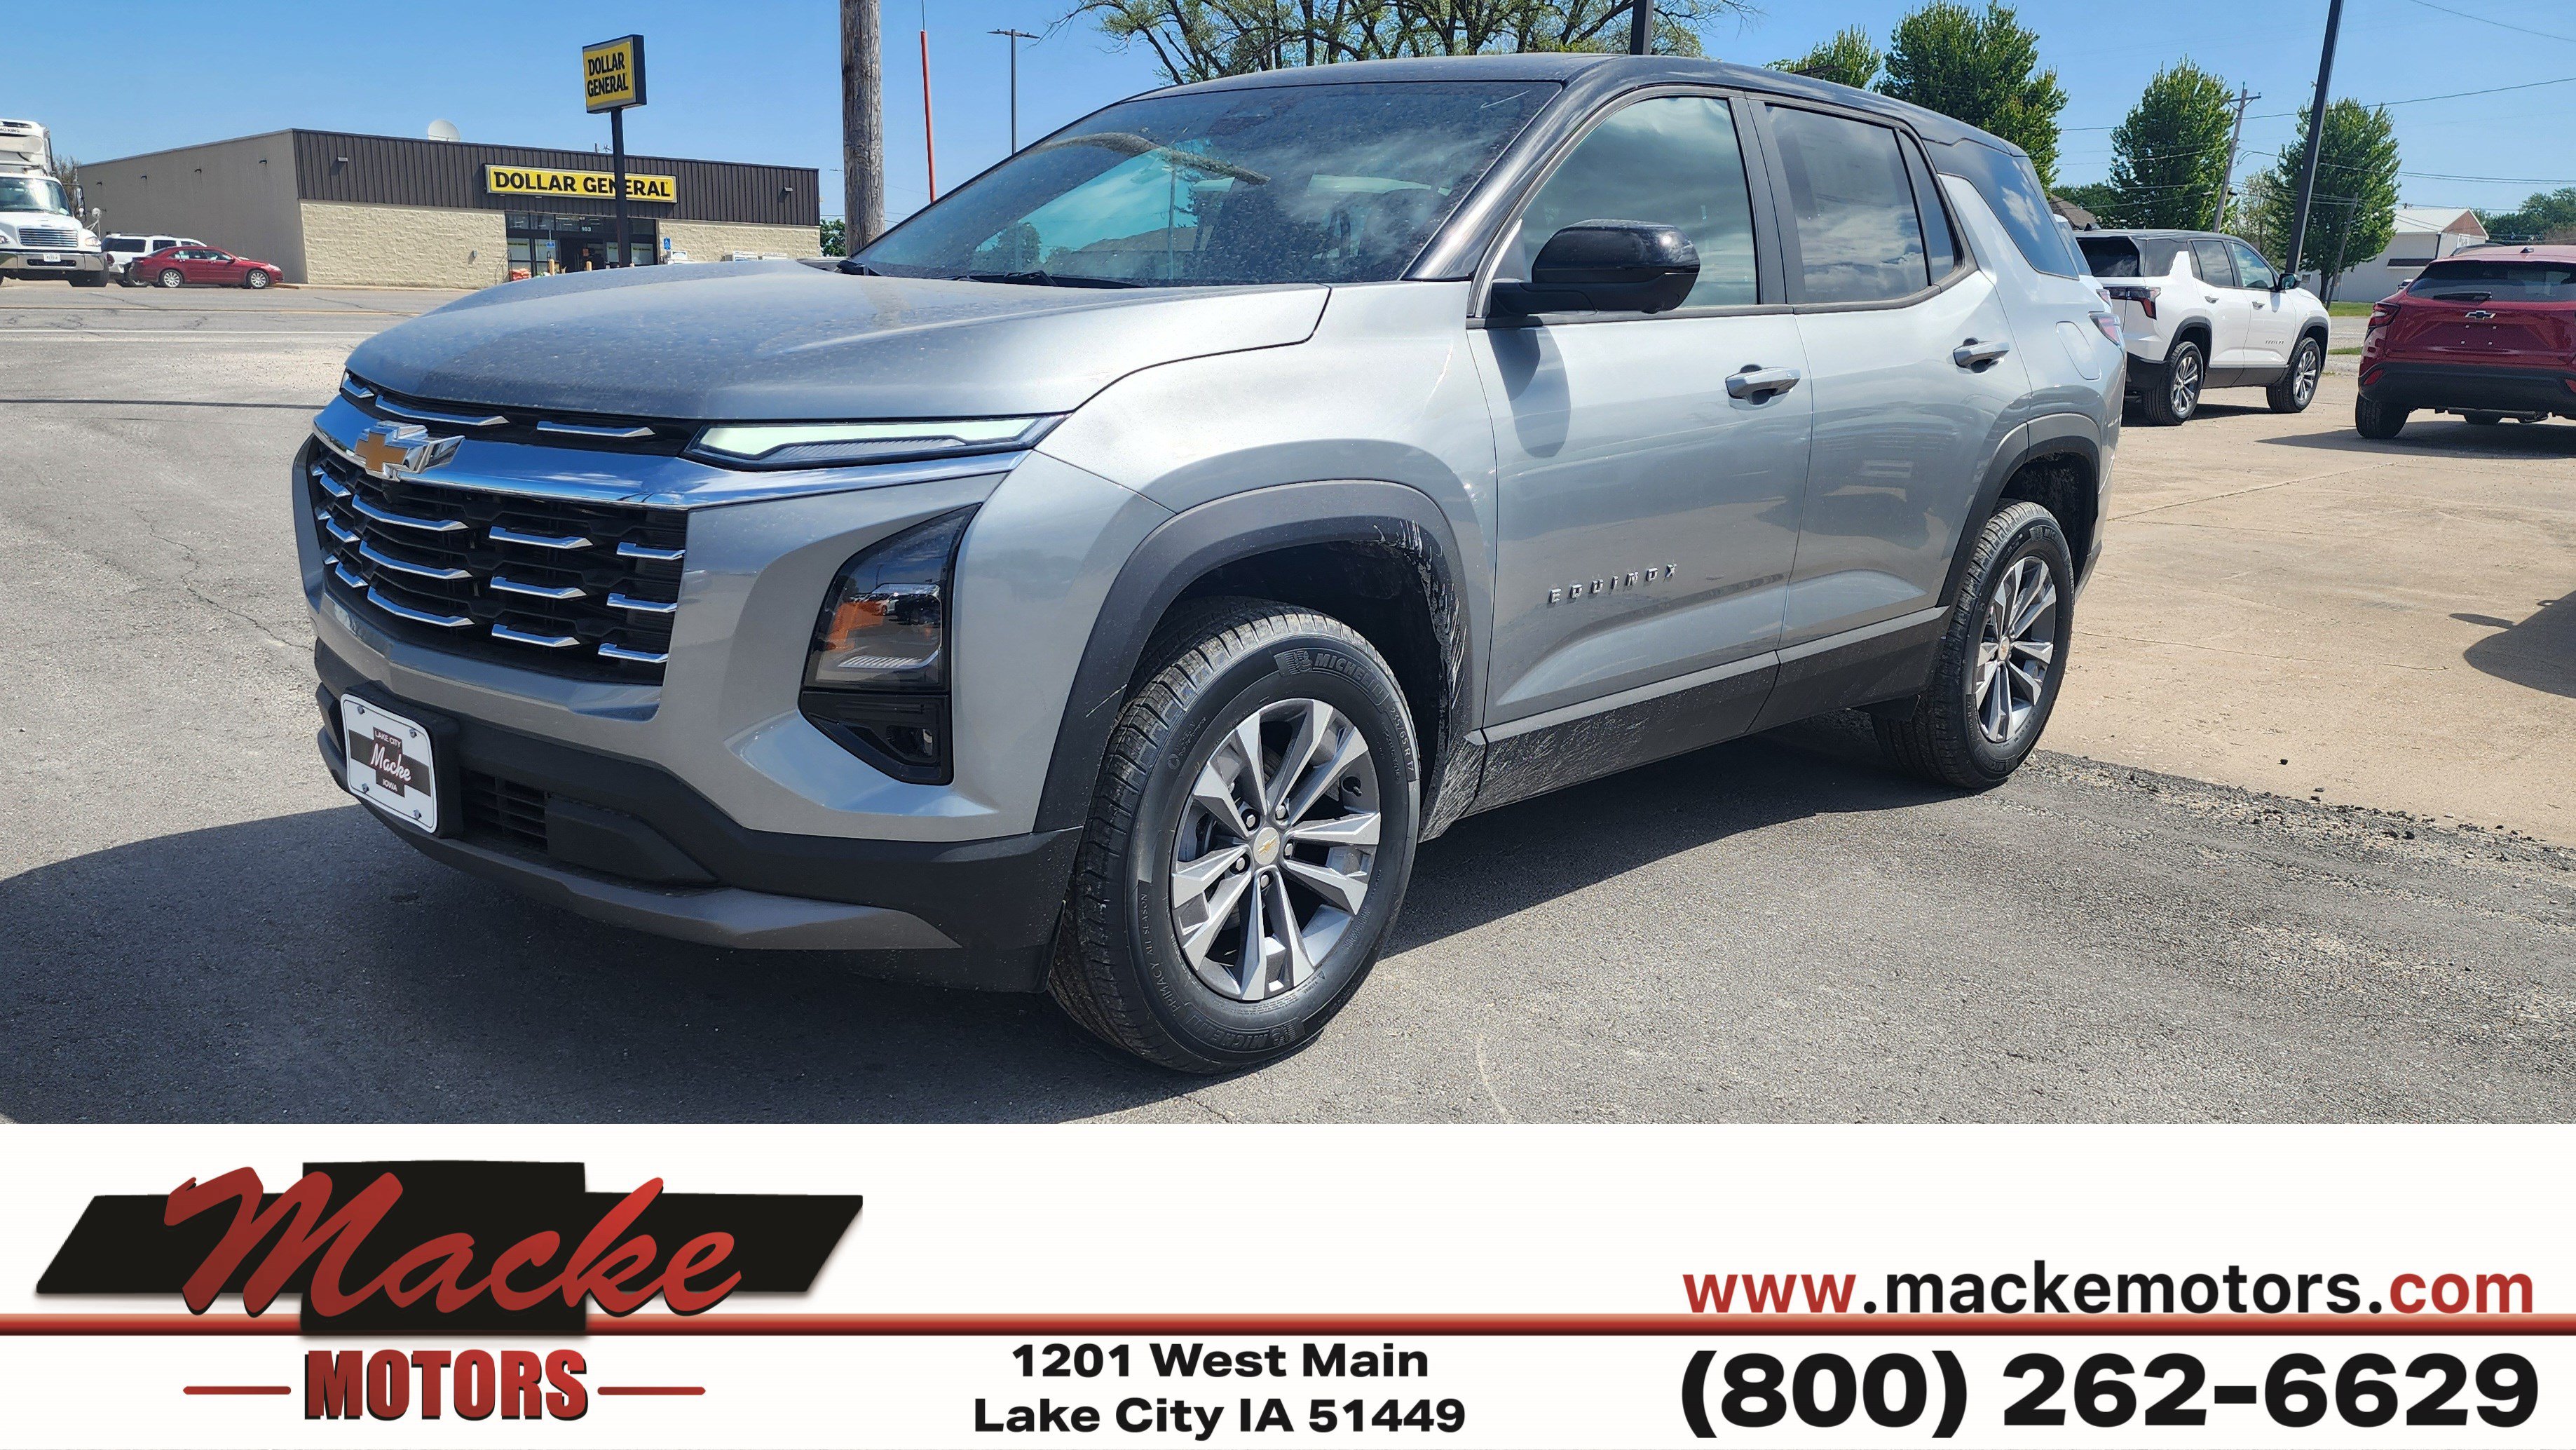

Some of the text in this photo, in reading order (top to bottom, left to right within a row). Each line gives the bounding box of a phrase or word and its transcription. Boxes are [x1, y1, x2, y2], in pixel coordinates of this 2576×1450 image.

[588, 52, 625, 76] DOLLAR
[587, 73, 628, 97] GENERAL
[494, 172, 670, 197] DOLLAR GENERAL
[1550, 563, 1677, 603] EQUINOX
[1314, 653, 1385, 701] MICHELIN
[374, 731, 402, 747] LAKE CITY
[1390, 707, 1409, 745] 235/65
[1404, 747, 1411, 756] R
[370, 743, 411, 782] Macke
[383, 778, 397, 792] IOWA
[1140, 893, 1150, 935] SEASON
[1150, 961, 1181, 1012] PRIMACY
